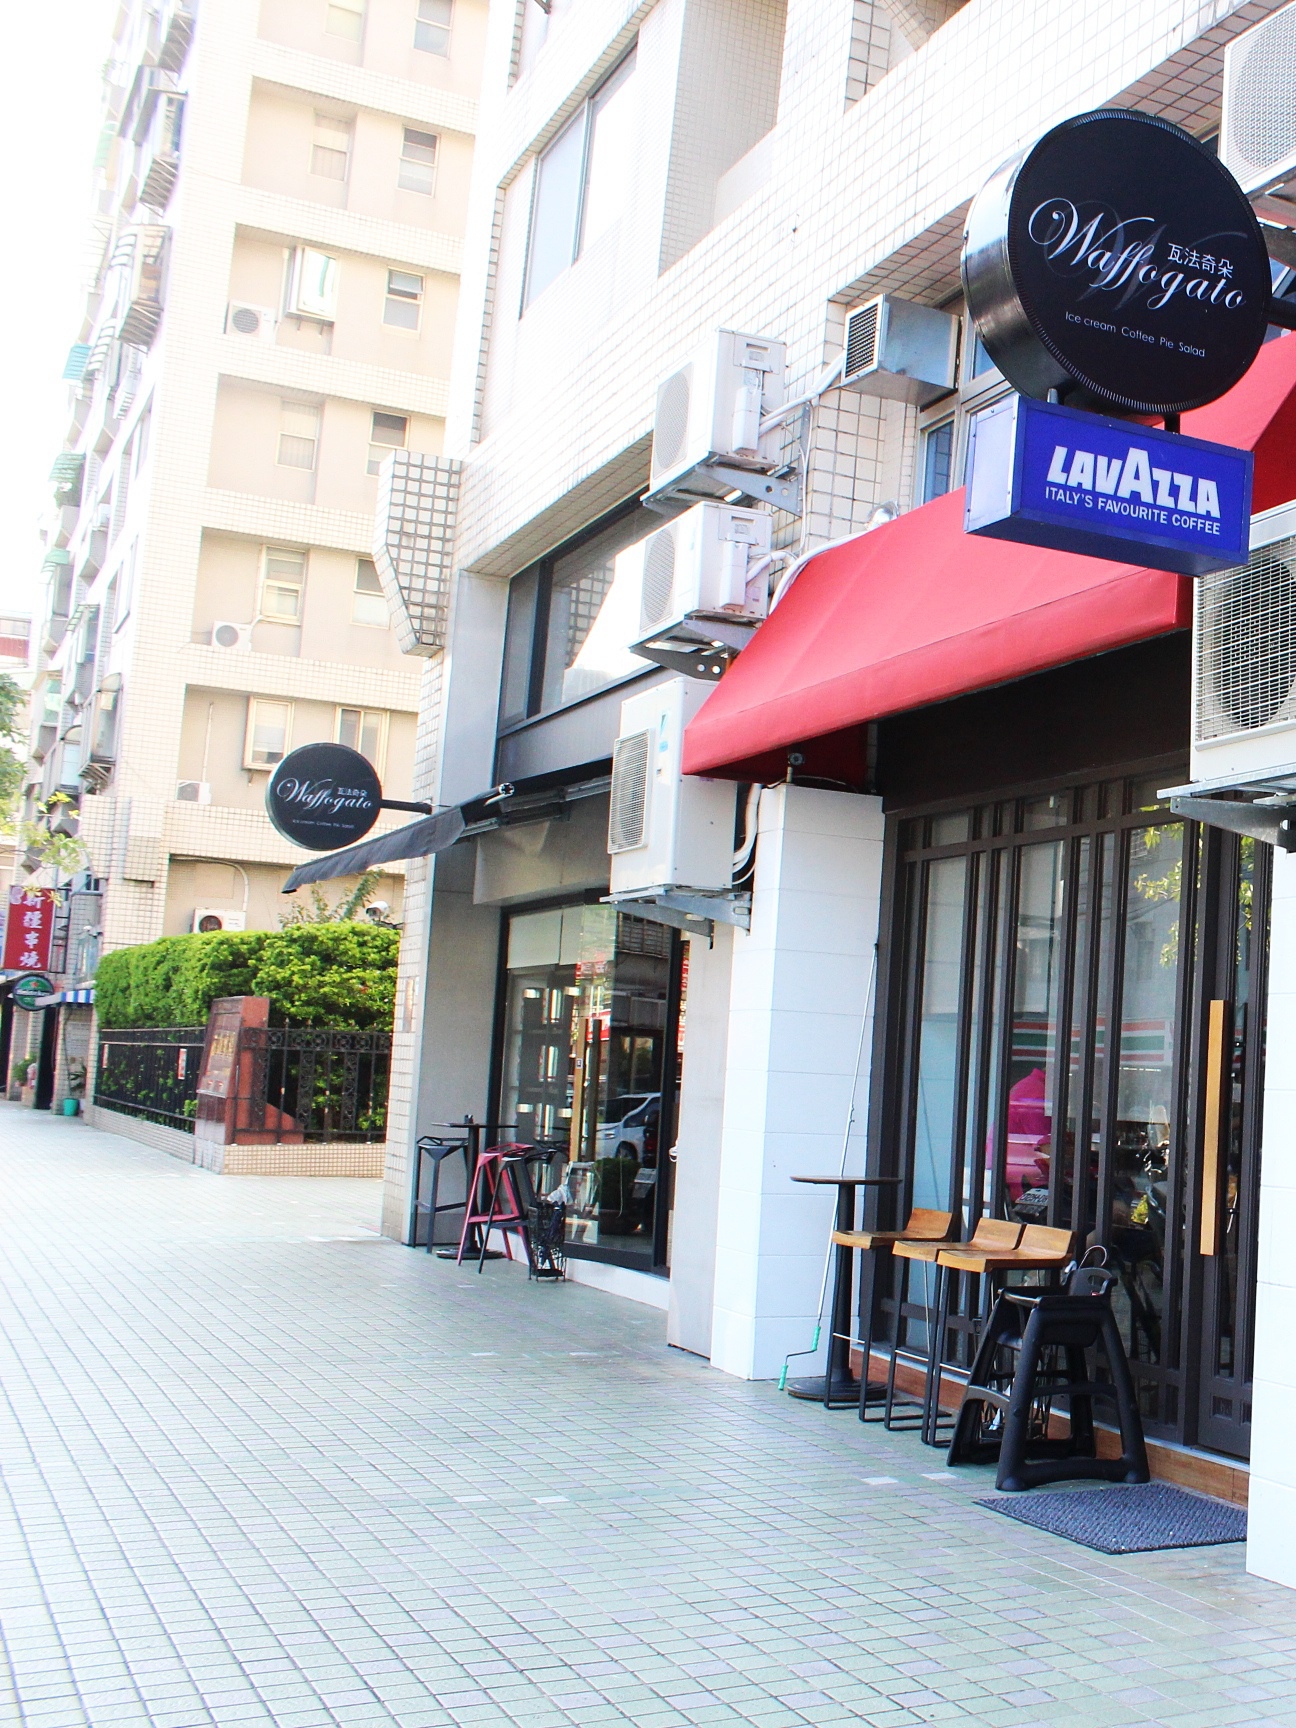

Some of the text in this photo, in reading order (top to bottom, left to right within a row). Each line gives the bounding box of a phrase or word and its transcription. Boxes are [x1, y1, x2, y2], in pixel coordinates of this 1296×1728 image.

[1028, 197, 1246, 309] Waffogato
[1167, 242, 1234, 279] 瓦法奇朵
[1065, 311, 1206, 357] Ice cream Coffee Pie Salad
[1046, 445, 1221, 519] LAVAZZA
[1045, 486, 1221, 535] ITALY'S FAVOURITE COFFEE
[277, 777, 372, 815] Waffogato
